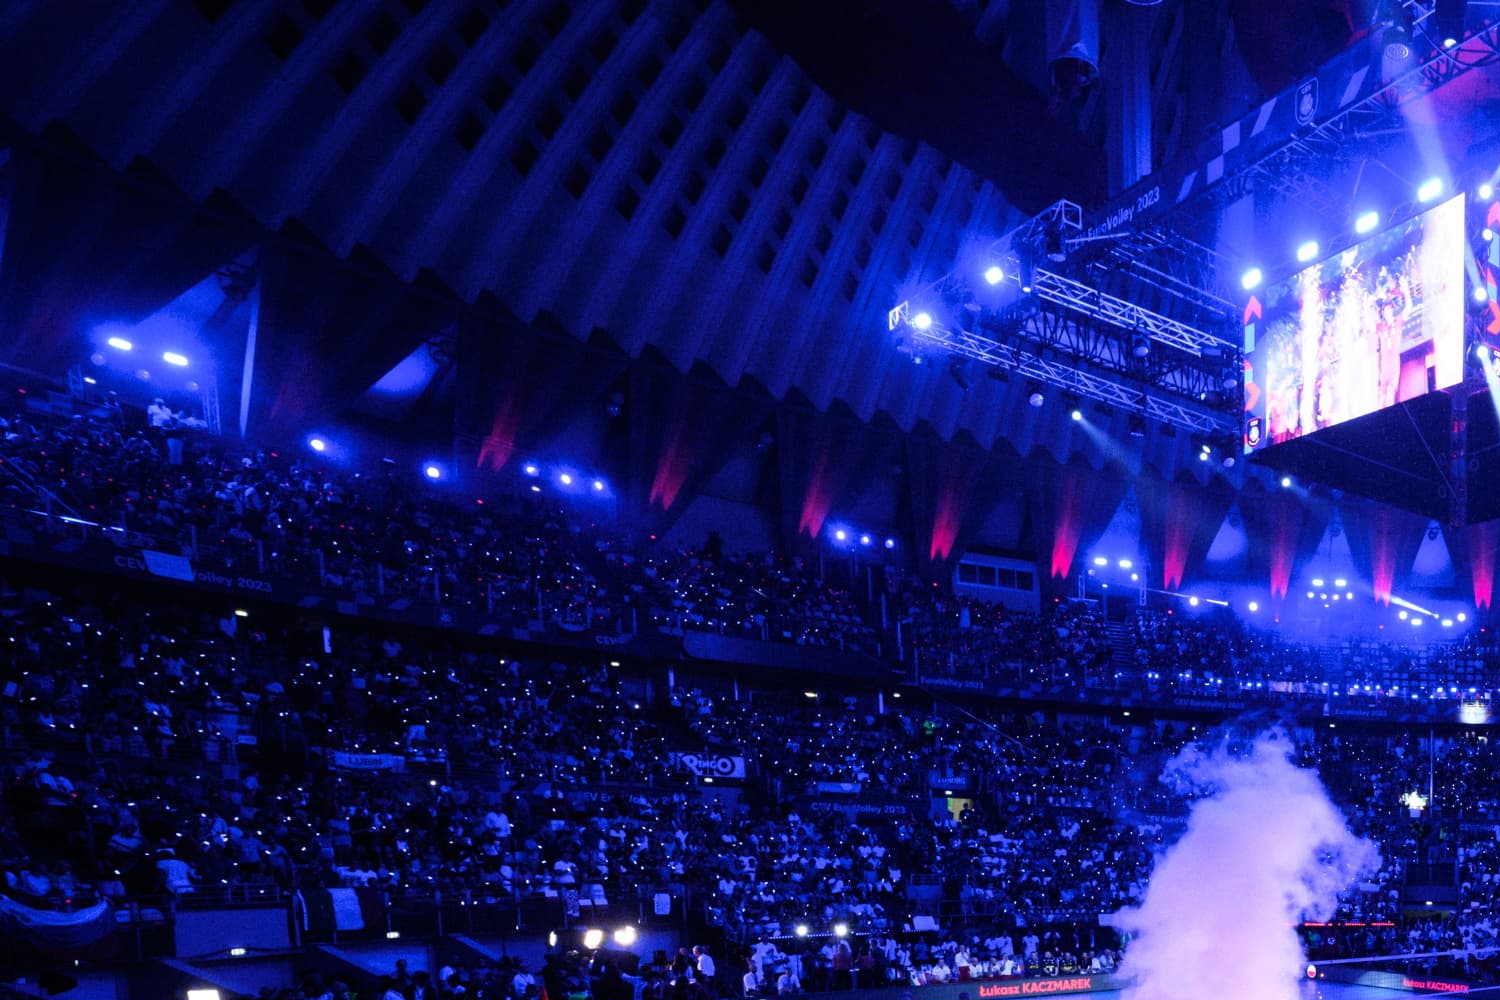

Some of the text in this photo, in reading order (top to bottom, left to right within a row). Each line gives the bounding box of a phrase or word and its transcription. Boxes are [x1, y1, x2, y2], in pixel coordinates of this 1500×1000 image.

[1137, 185, 1160, 212] 2023
[237, 576, 273, 593] 2023
[979, 978, 1092, 997] Łukasz KACZMAREK
